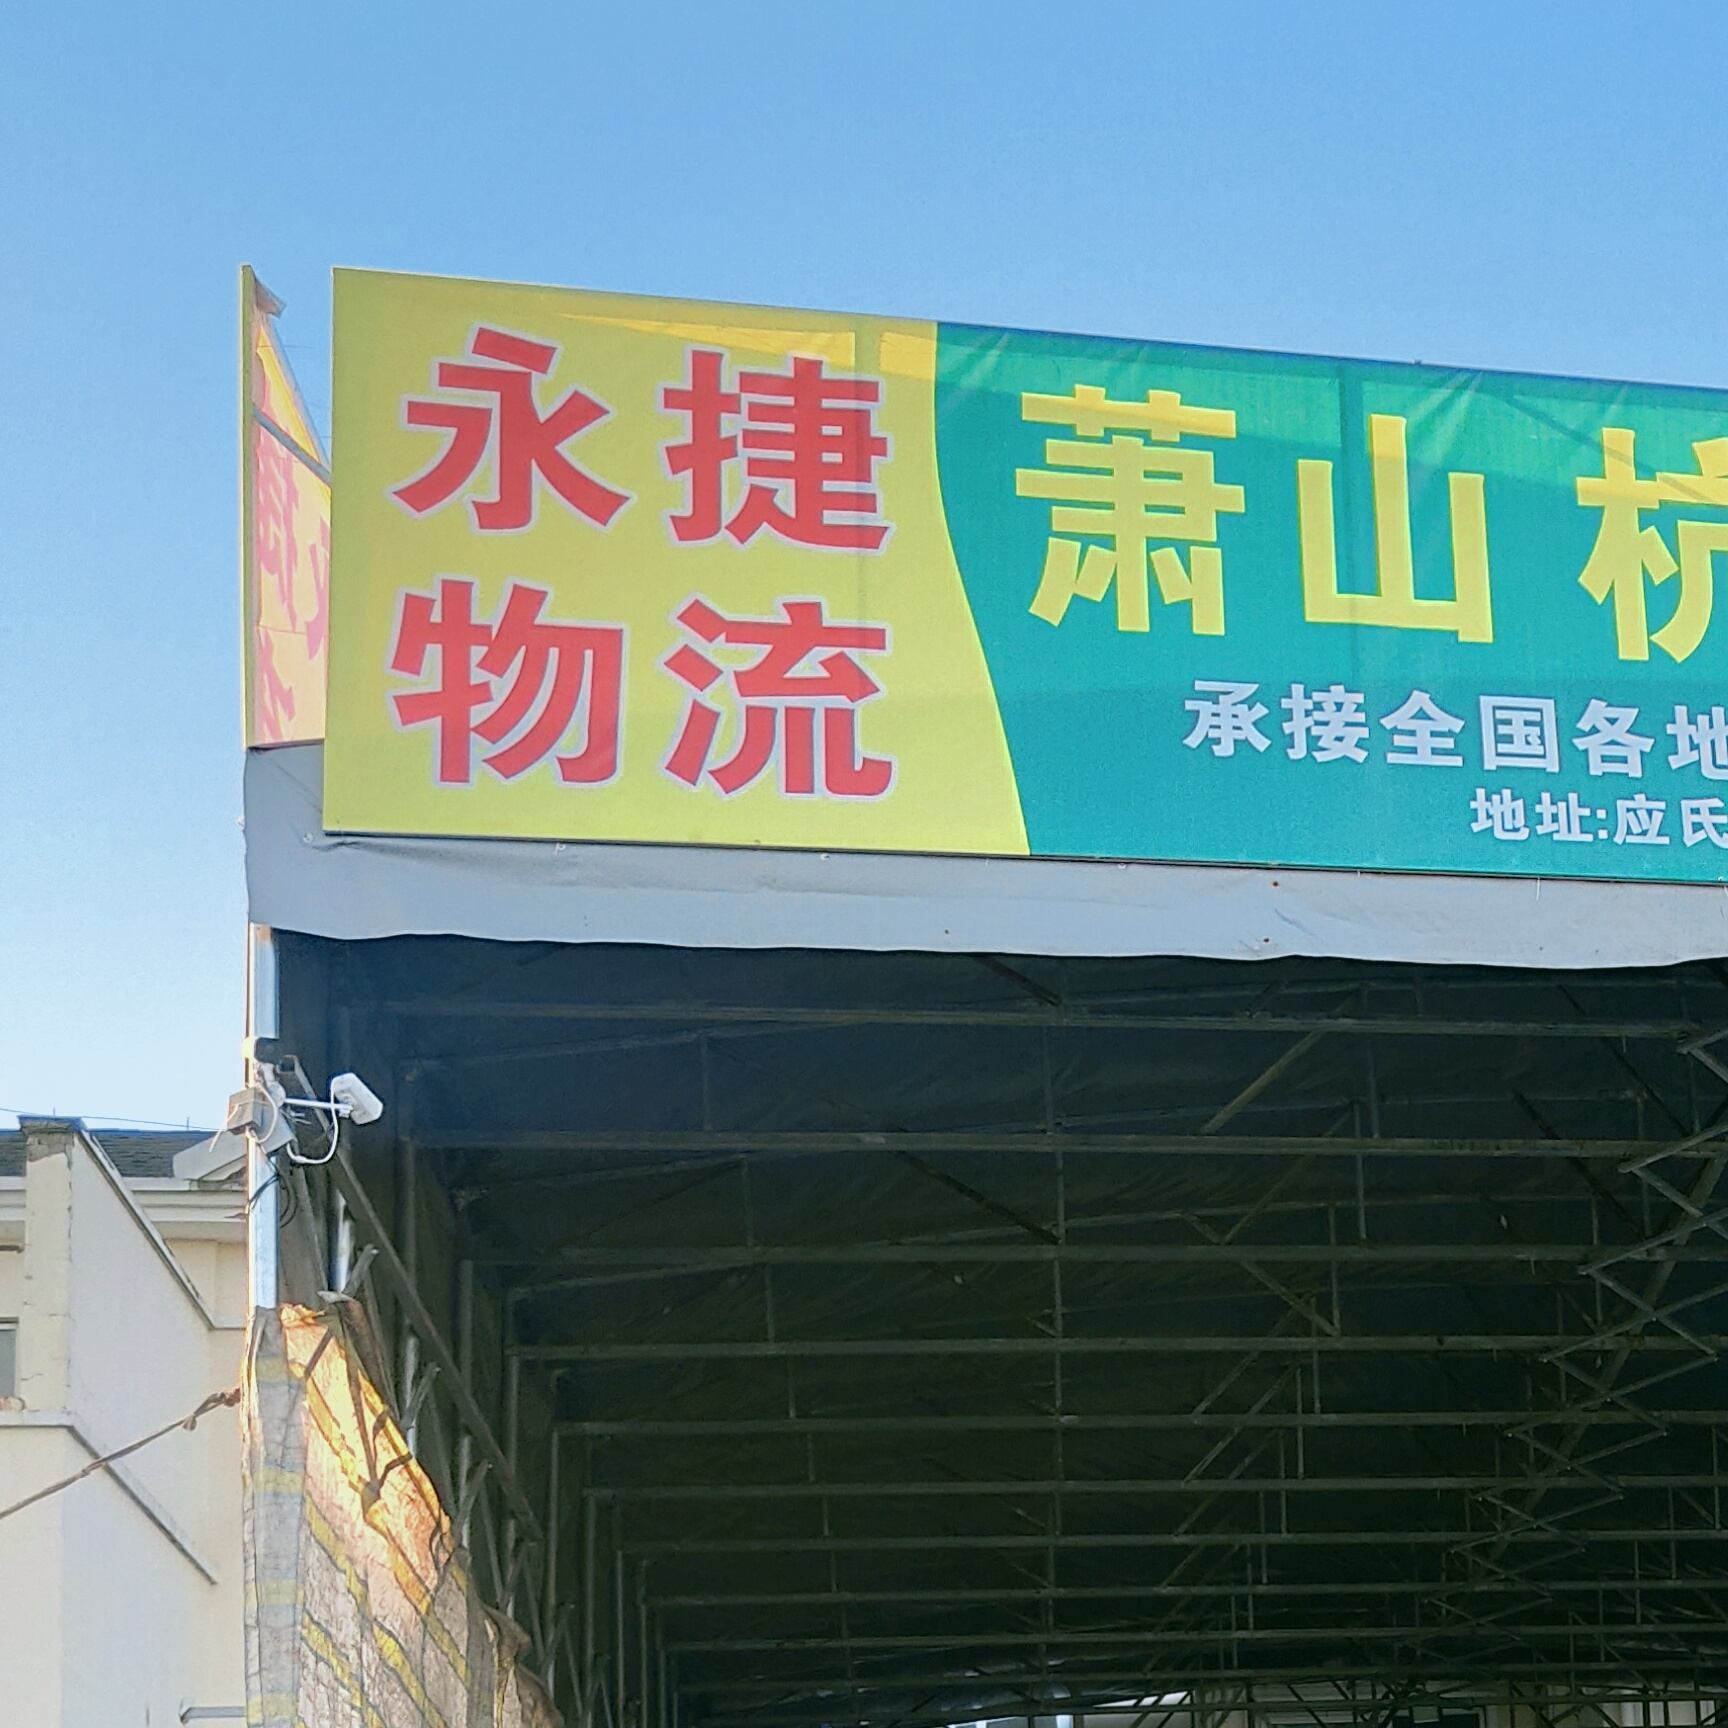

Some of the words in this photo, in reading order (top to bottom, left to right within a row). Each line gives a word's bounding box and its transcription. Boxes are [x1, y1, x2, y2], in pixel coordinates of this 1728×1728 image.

[392, 326, 891, 551] 永捷
[1014, 384, 1495, 645] 萧山
[390, 578, 895, 797] 物流
